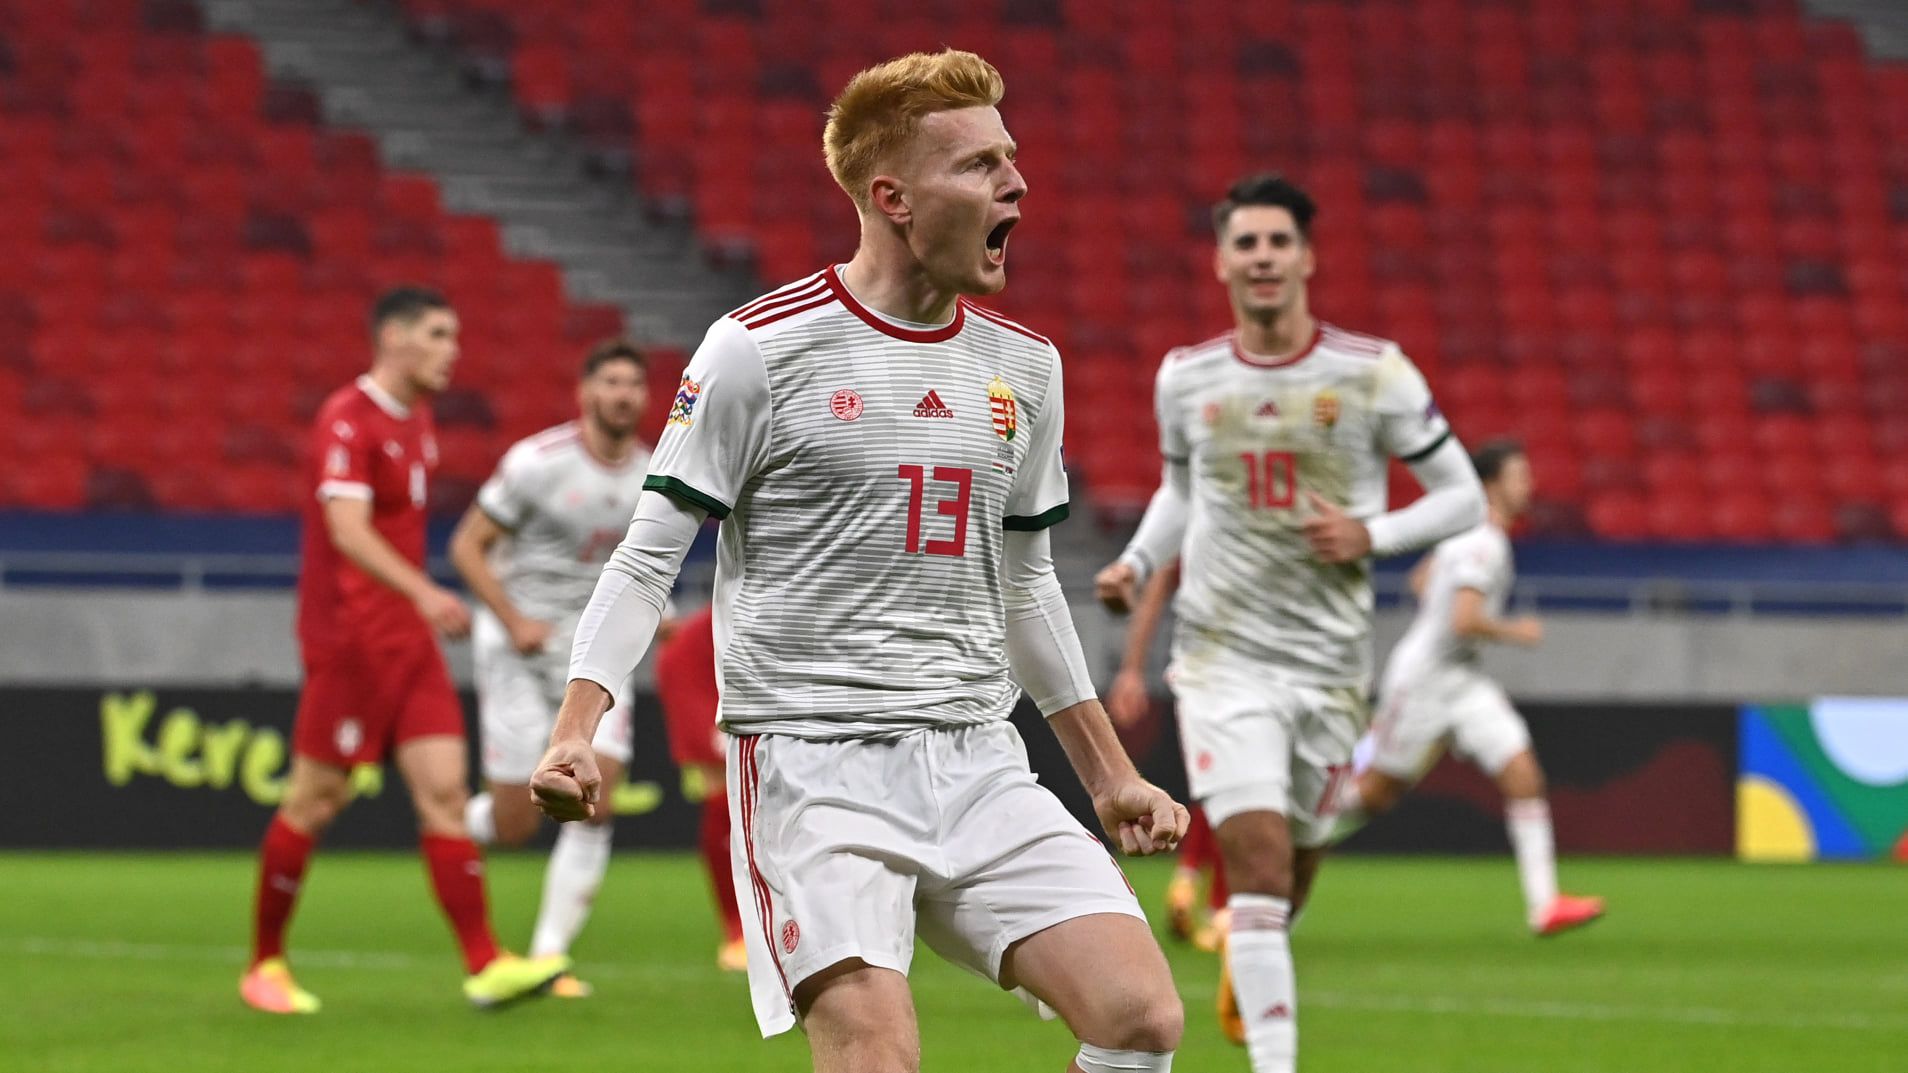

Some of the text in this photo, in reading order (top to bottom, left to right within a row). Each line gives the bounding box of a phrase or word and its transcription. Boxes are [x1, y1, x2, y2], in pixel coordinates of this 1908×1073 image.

[913, 408, 954, 419] adidas
[898, 464, 973, 557] 13
[1241, 451, 1295, 511] 10
[101, 690, 383, 806] Kere
